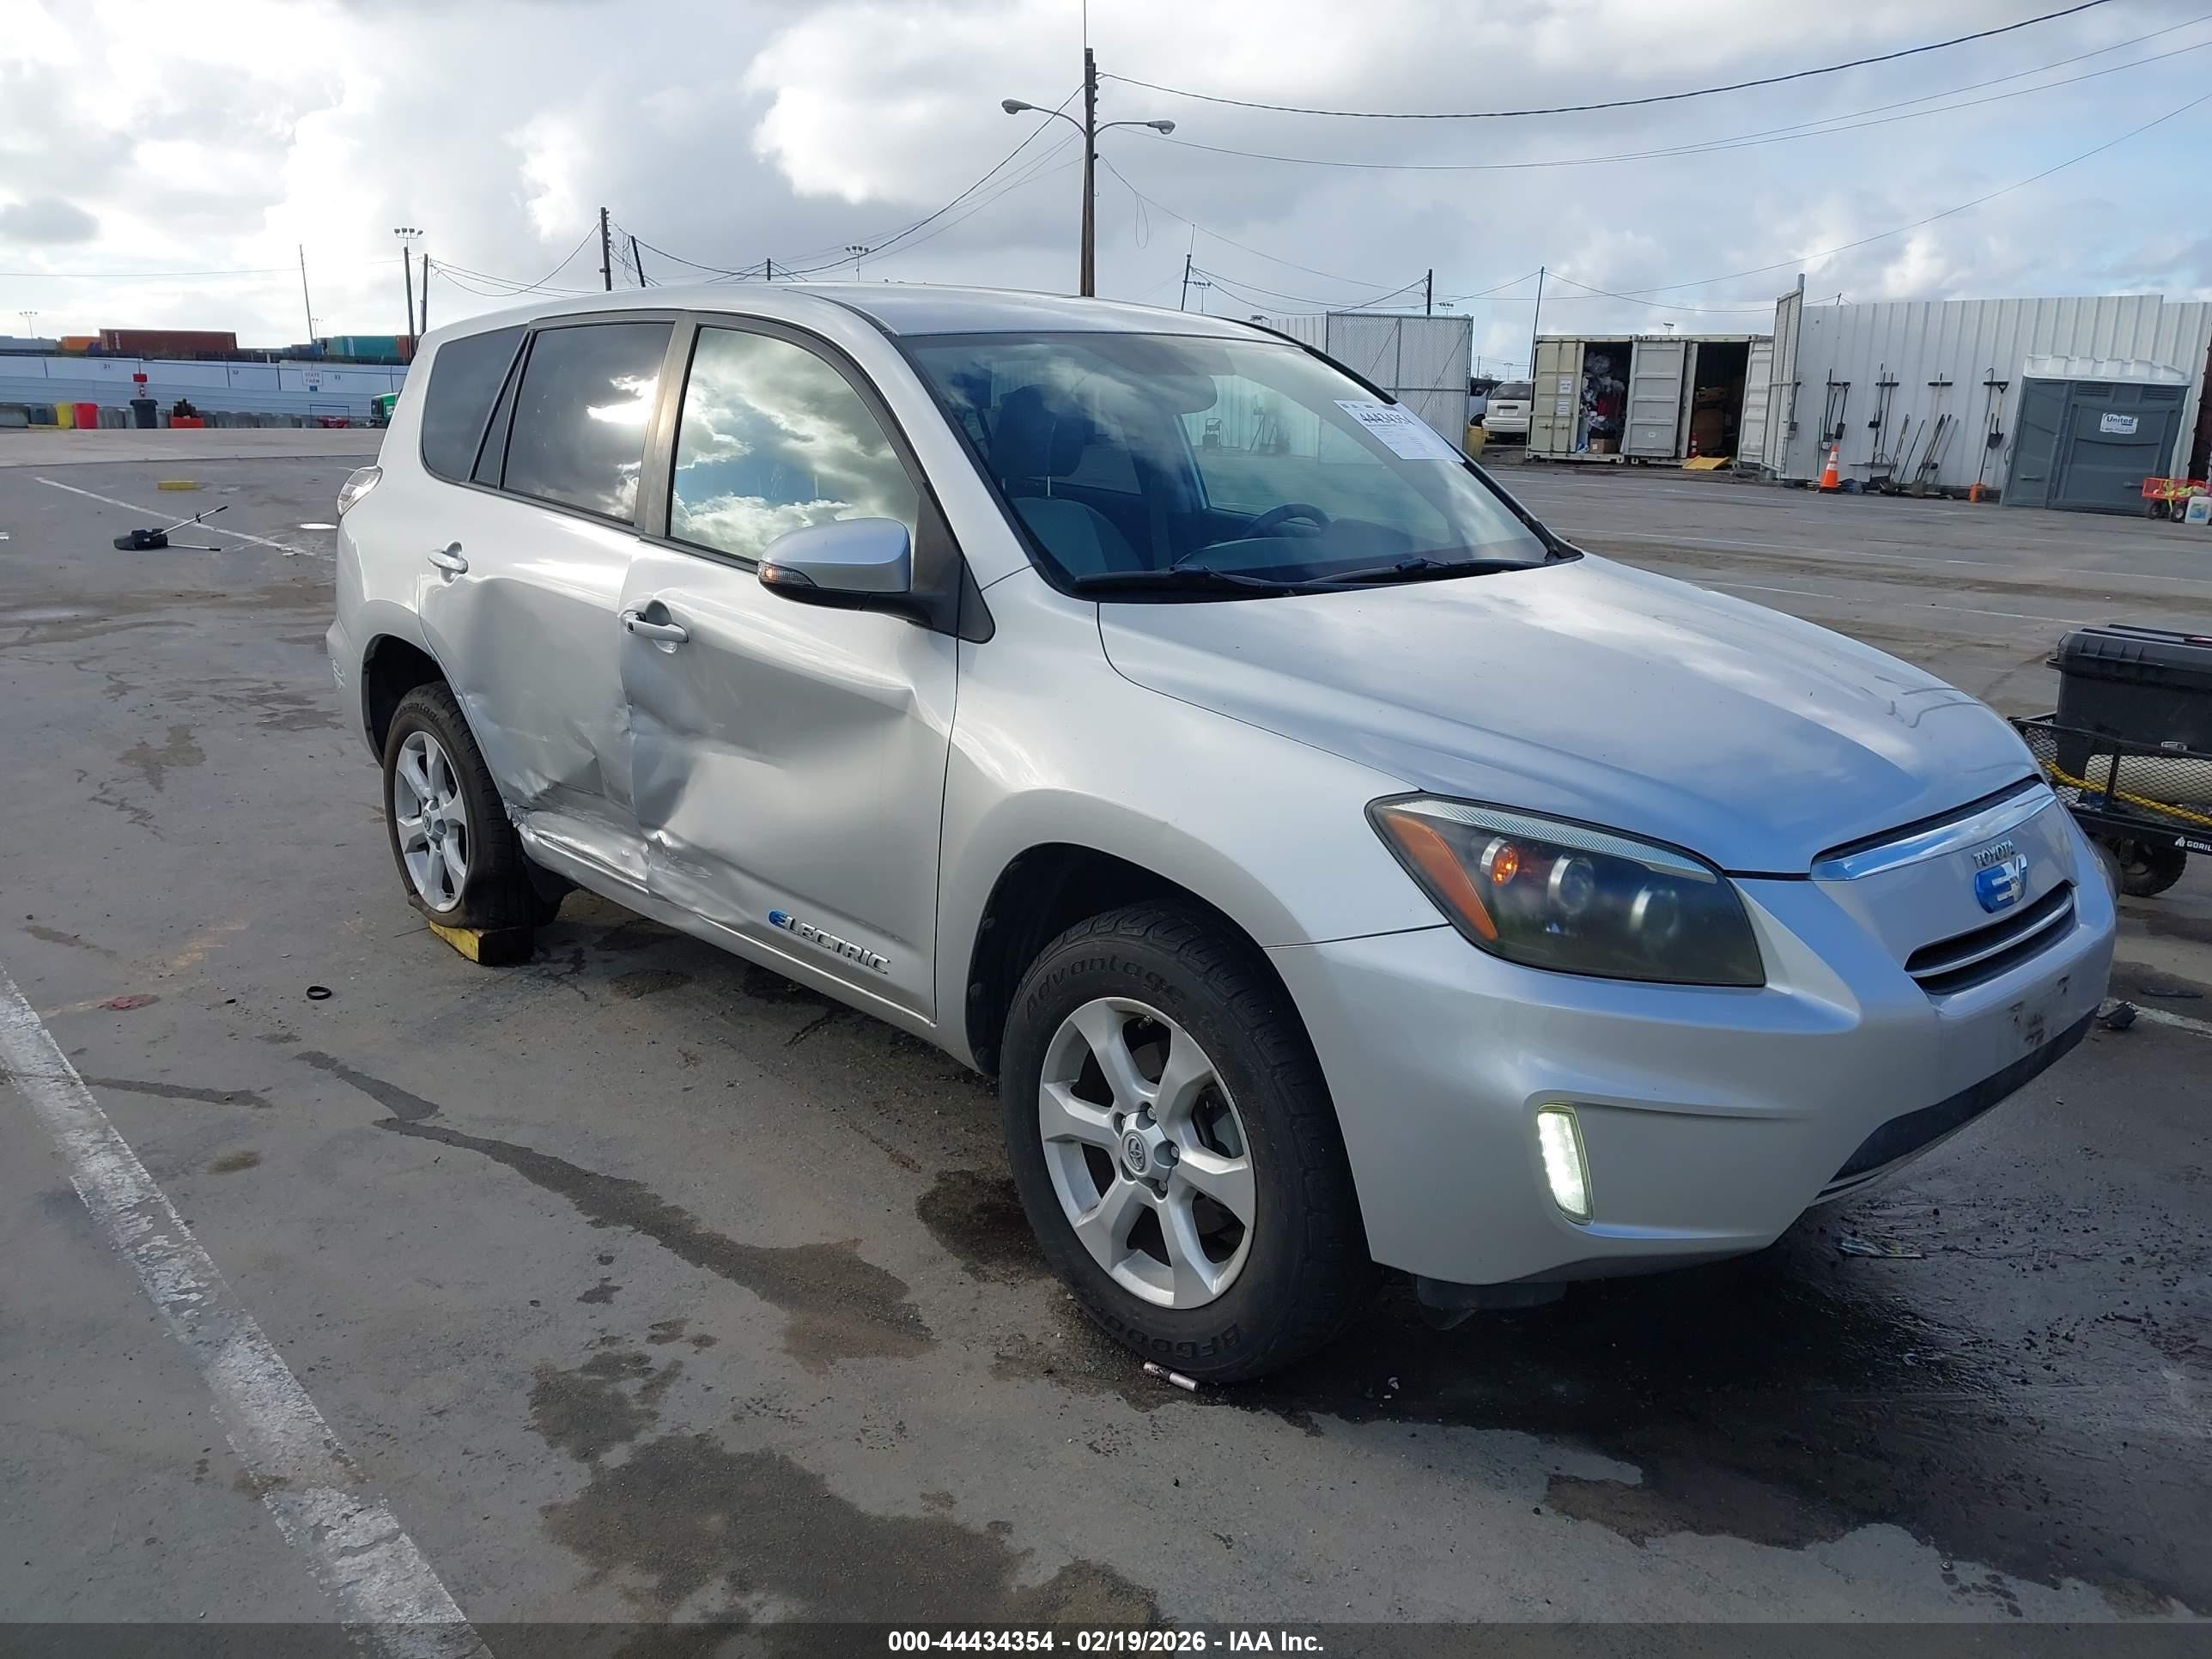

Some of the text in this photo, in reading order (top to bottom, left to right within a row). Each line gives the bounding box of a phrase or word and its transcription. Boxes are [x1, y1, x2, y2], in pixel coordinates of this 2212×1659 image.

[2106, 416, 2135, 424] United
[1972, 839, 2015, 870] TOYOTA
[767, 908, 891, 975] ELECTRIC
